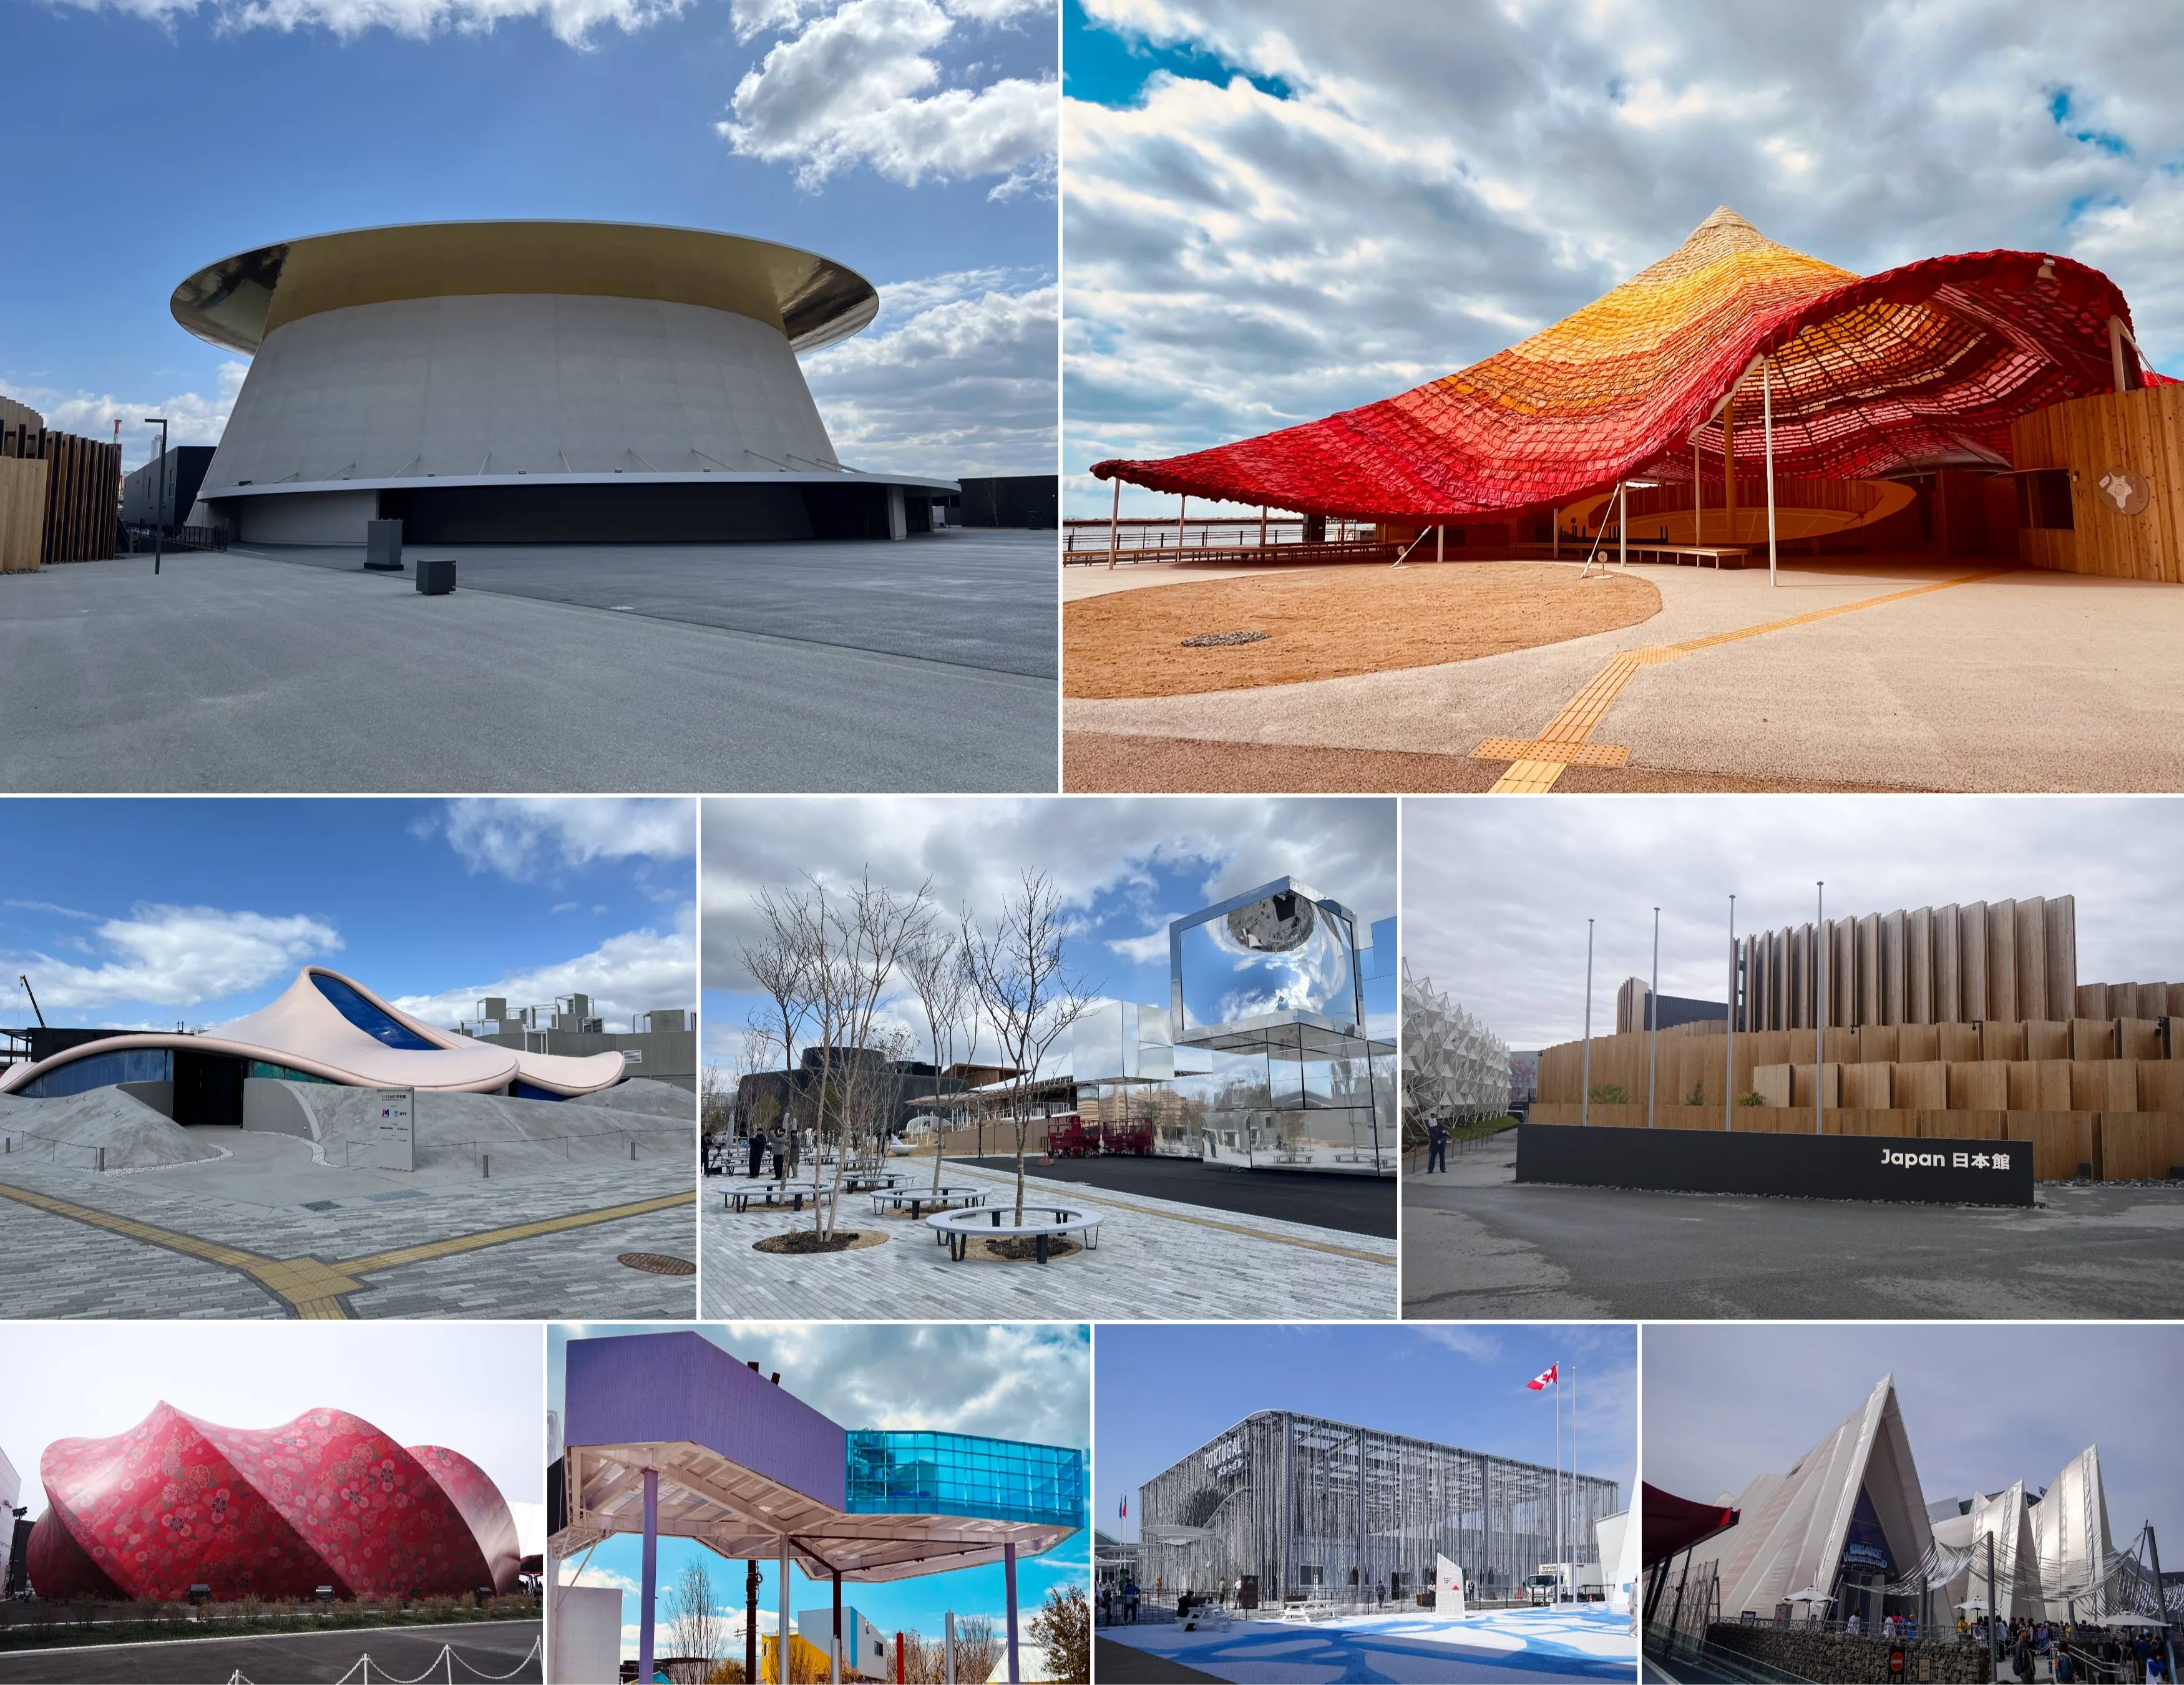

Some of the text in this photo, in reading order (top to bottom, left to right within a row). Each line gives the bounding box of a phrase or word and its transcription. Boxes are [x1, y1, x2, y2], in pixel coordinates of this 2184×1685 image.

[1881, 1148, 2010, 1170] Japan 日本館
[1204, 1434, 1242, 1471] PORTUGAL
[1217, 1458, 1243, 1477] ポルトガル
